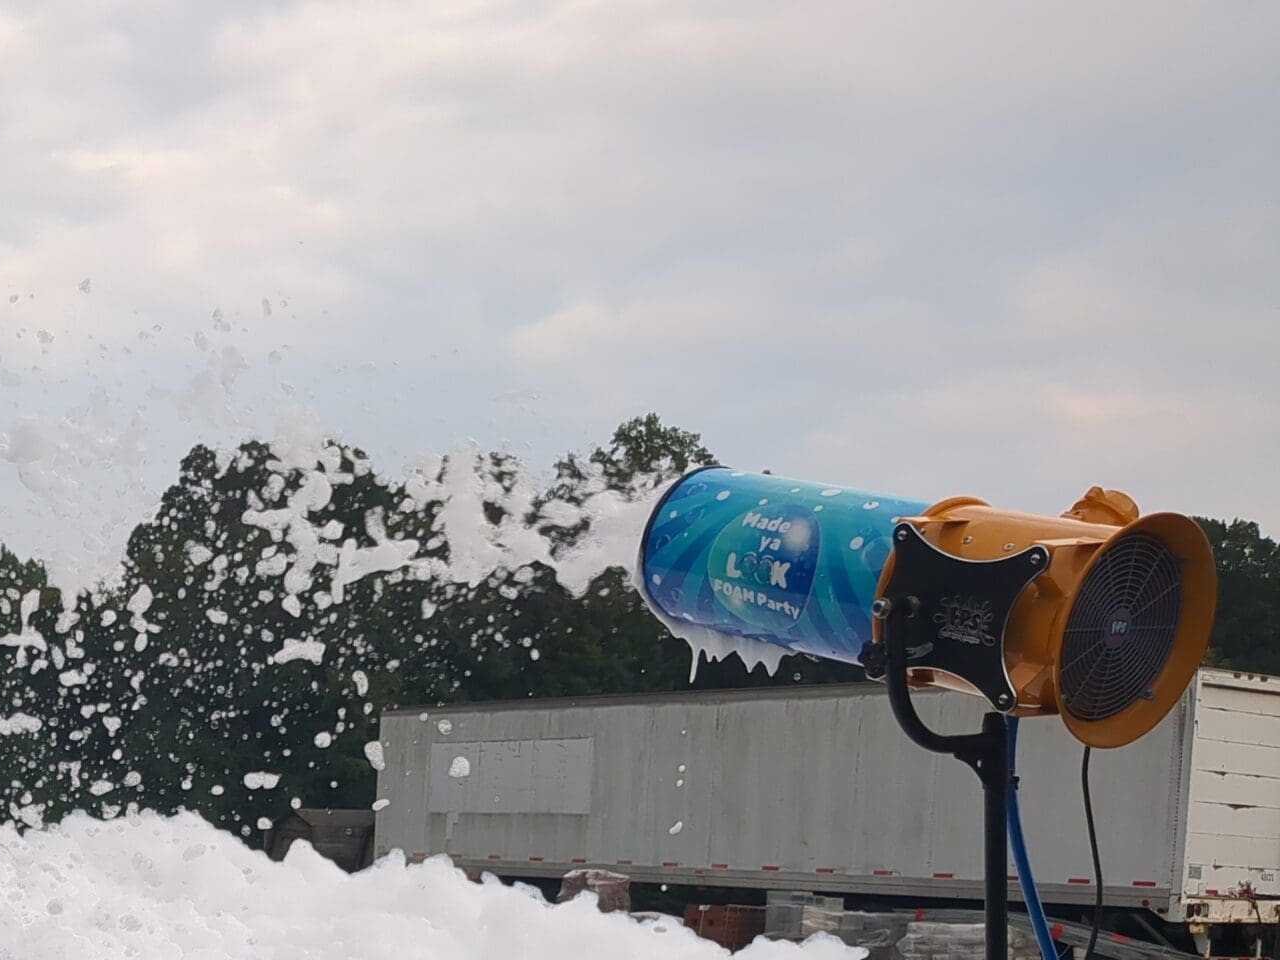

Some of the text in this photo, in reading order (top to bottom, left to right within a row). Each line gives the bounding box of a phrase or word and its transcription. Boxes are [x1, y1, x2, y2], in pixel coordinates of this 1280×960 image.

[742, 512, 791, 533] Made
[759, 536, 781, 552] ya
[713, 579, 800, 620] FOAM Party
